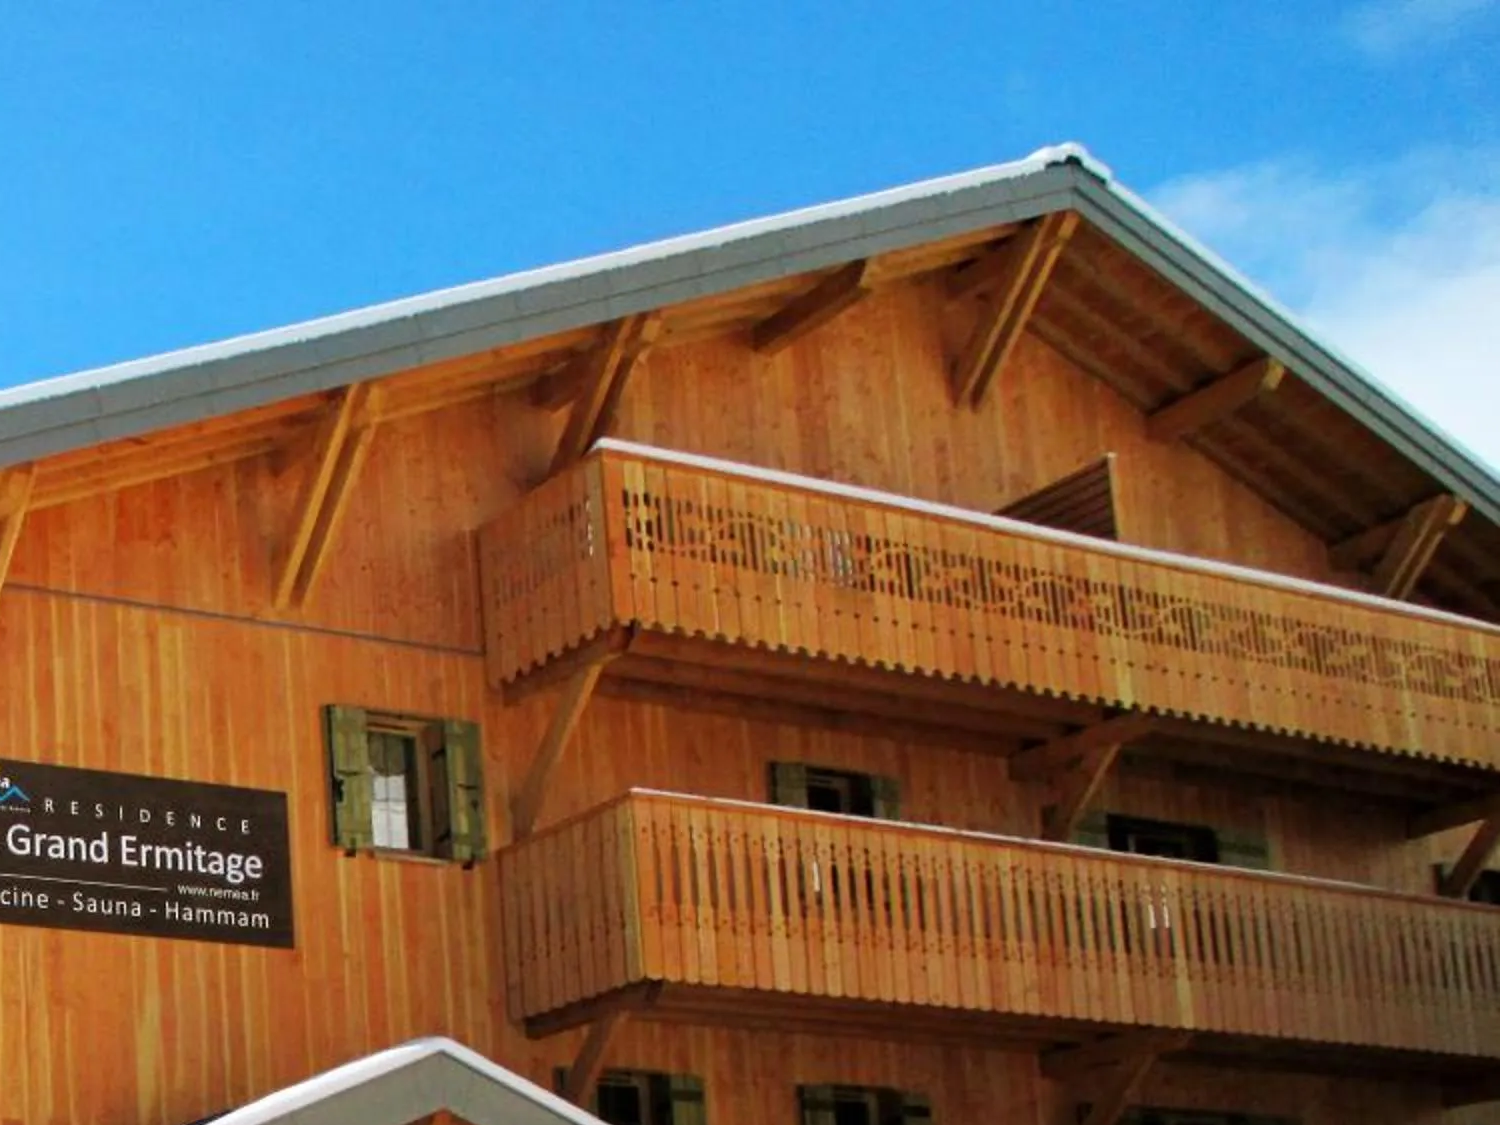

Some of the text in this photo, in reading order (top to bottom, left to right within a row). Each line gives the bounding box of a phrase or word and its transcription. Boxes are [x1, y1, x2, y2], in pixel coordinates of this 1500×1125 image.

[44, 798, 251, 835] RESIDENCE
[6, 823, 109, 864] Grand
[120, 835, 264, 884] Ermitage
[72, 891, 142, 917] Sauna
[165, 900, 270, 929] Hammam
